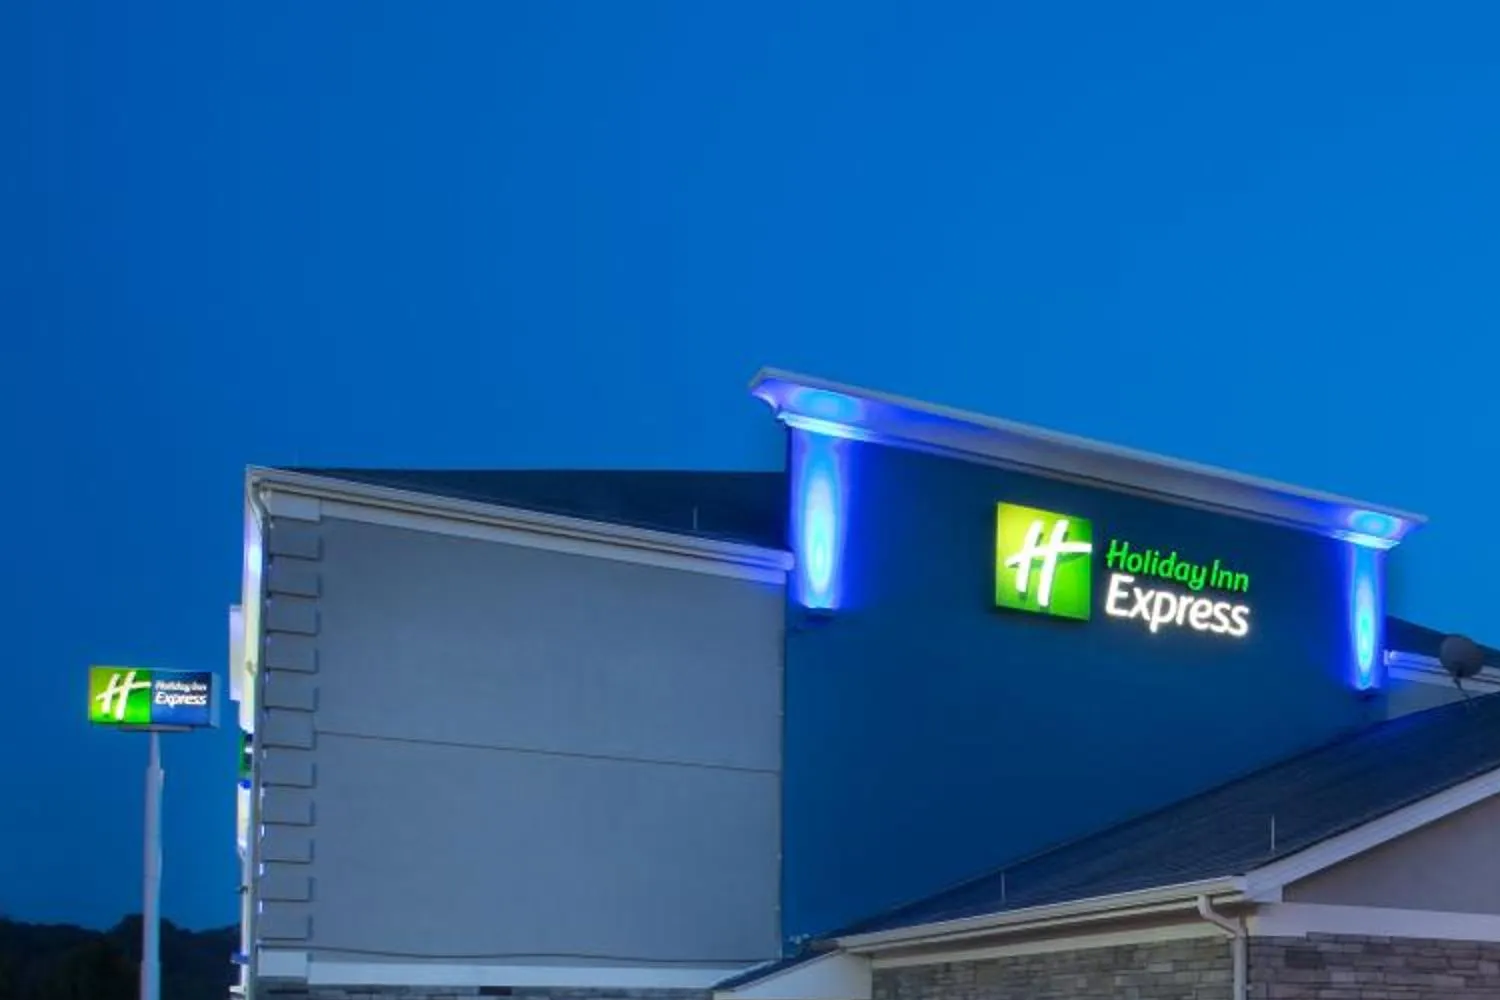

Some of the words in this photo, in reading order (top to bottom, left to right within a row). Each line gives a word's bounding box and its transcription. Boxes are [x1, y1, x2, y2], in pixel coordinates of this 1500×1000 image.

[1105, 539, 1207, 590] Holiday
[1211, 559, 1249, 592] Inn
[1104, 572, 1250, 637] Express
[155, 691, 207, 708] Express
